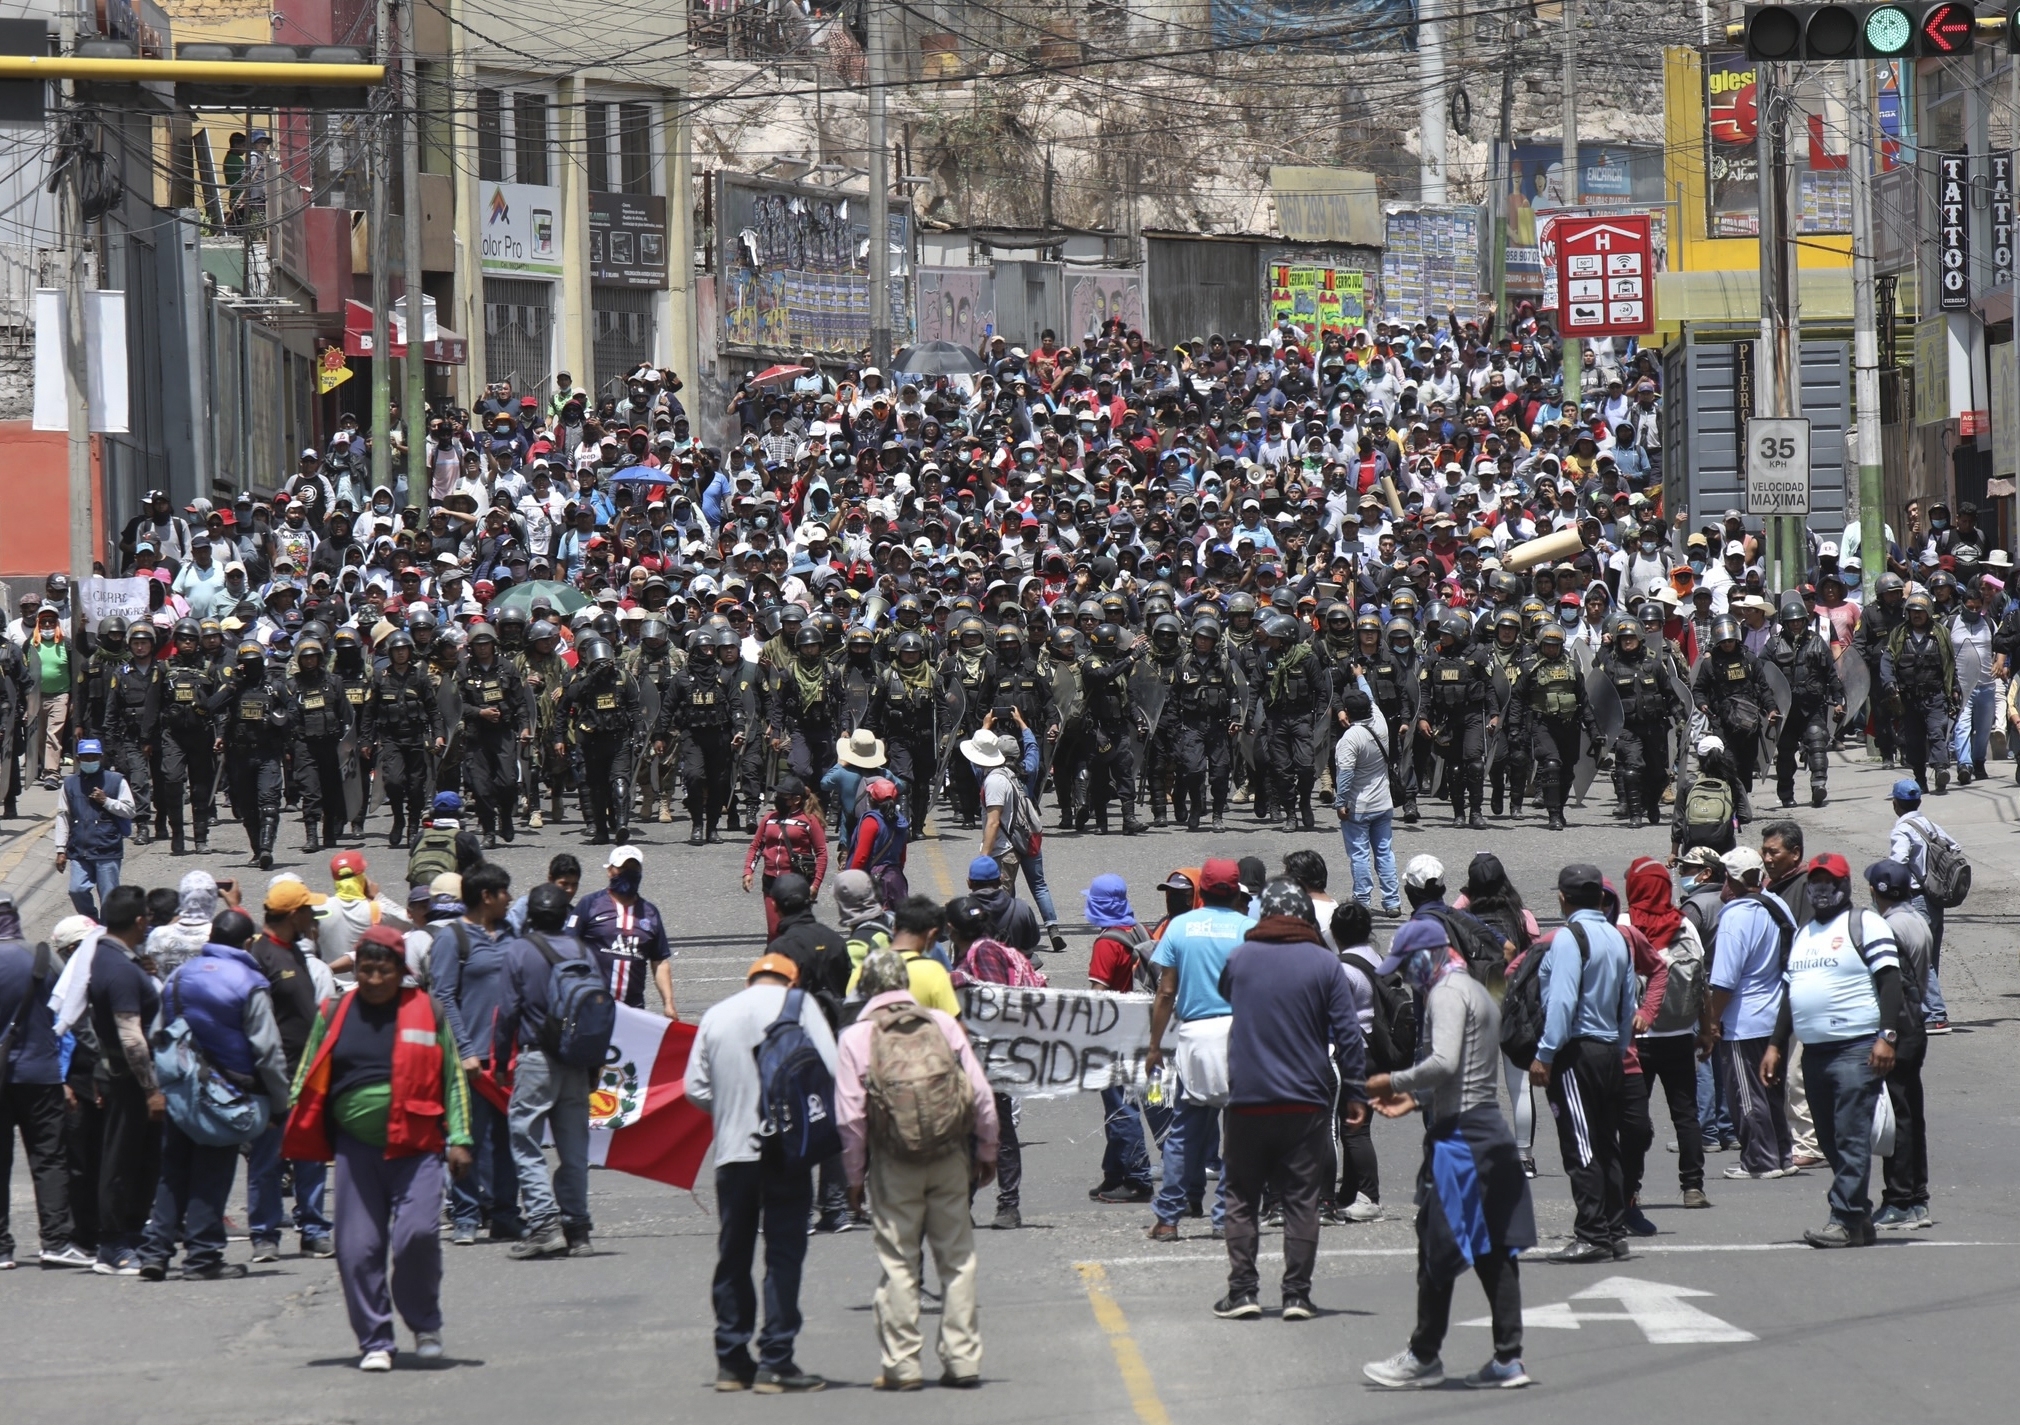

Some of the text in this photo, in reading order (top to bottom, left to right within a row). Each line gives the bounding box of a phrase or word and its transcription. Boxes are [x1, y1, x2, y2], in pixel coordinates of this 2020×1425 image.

[1587, 167, 1622, 182] ENCARGA
[1278, 191, 1350, 237] 960 299 799
[1943, 159, 1964, 290] TATTOO
[1993, 158, 2012, 285] TATTOO
[505, 235, 522, 259] Pro
[1595, 233, 1610, 250] H
[1506, 250, 1517, 262] 958
[1520, 250, 1531, 262] 907
[1760, 437, 1796, 459] 35
[1752, 482, 1804, 492] VELOCIDAD
[1751, 493, 1806, 506] MAXIMA
[960, 986, 1120, 1036] IBERTAD
